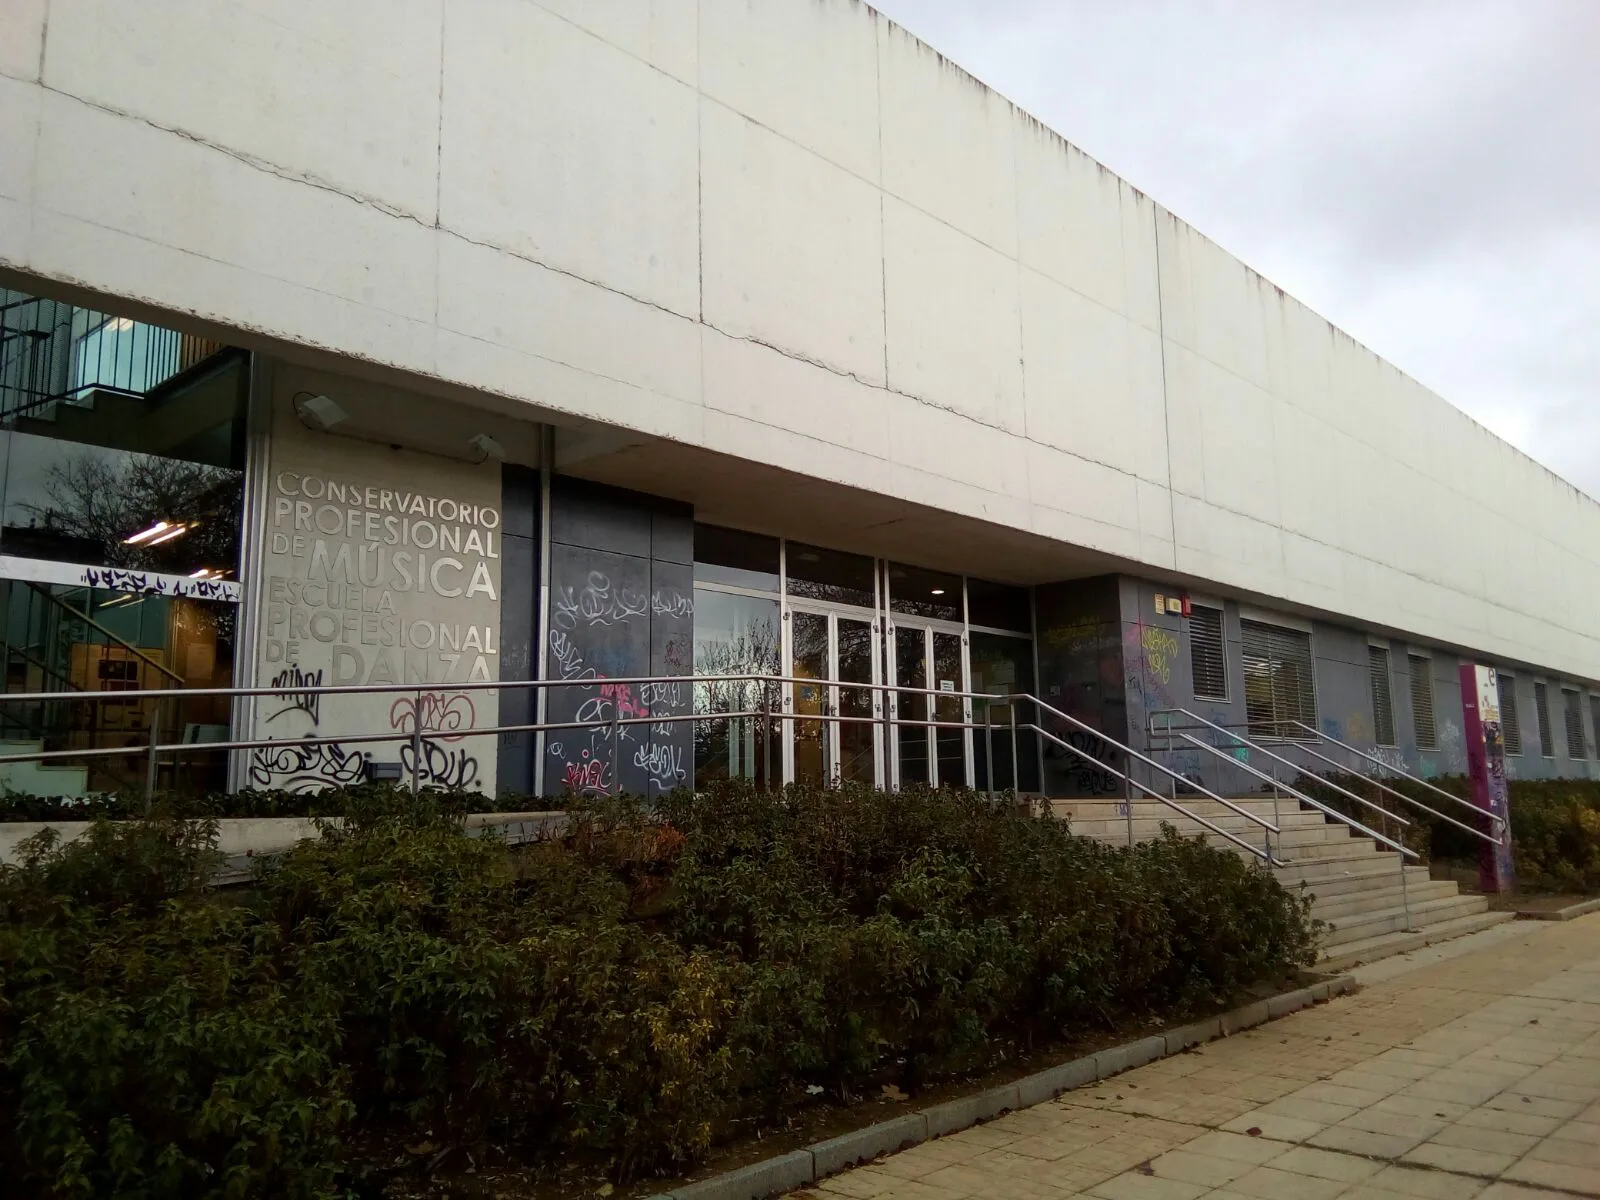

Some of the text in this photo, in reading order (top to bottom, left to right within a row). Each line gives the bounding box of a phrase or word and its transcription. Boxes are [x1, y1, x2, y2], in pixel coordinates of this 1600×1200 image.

[273, 496, 499, 558] PROFESIONAL
[276, 471, 499, 529] CONSERVATORIO
[269, 575, 397, 615] ESCUELA
[271, 532, 498, 601] DE MÚSICA
[266, 602, 497, 655] PROFESIONAL
[265, 639, 301, 664] DE
[331, 643, 498, 696] DANZA
